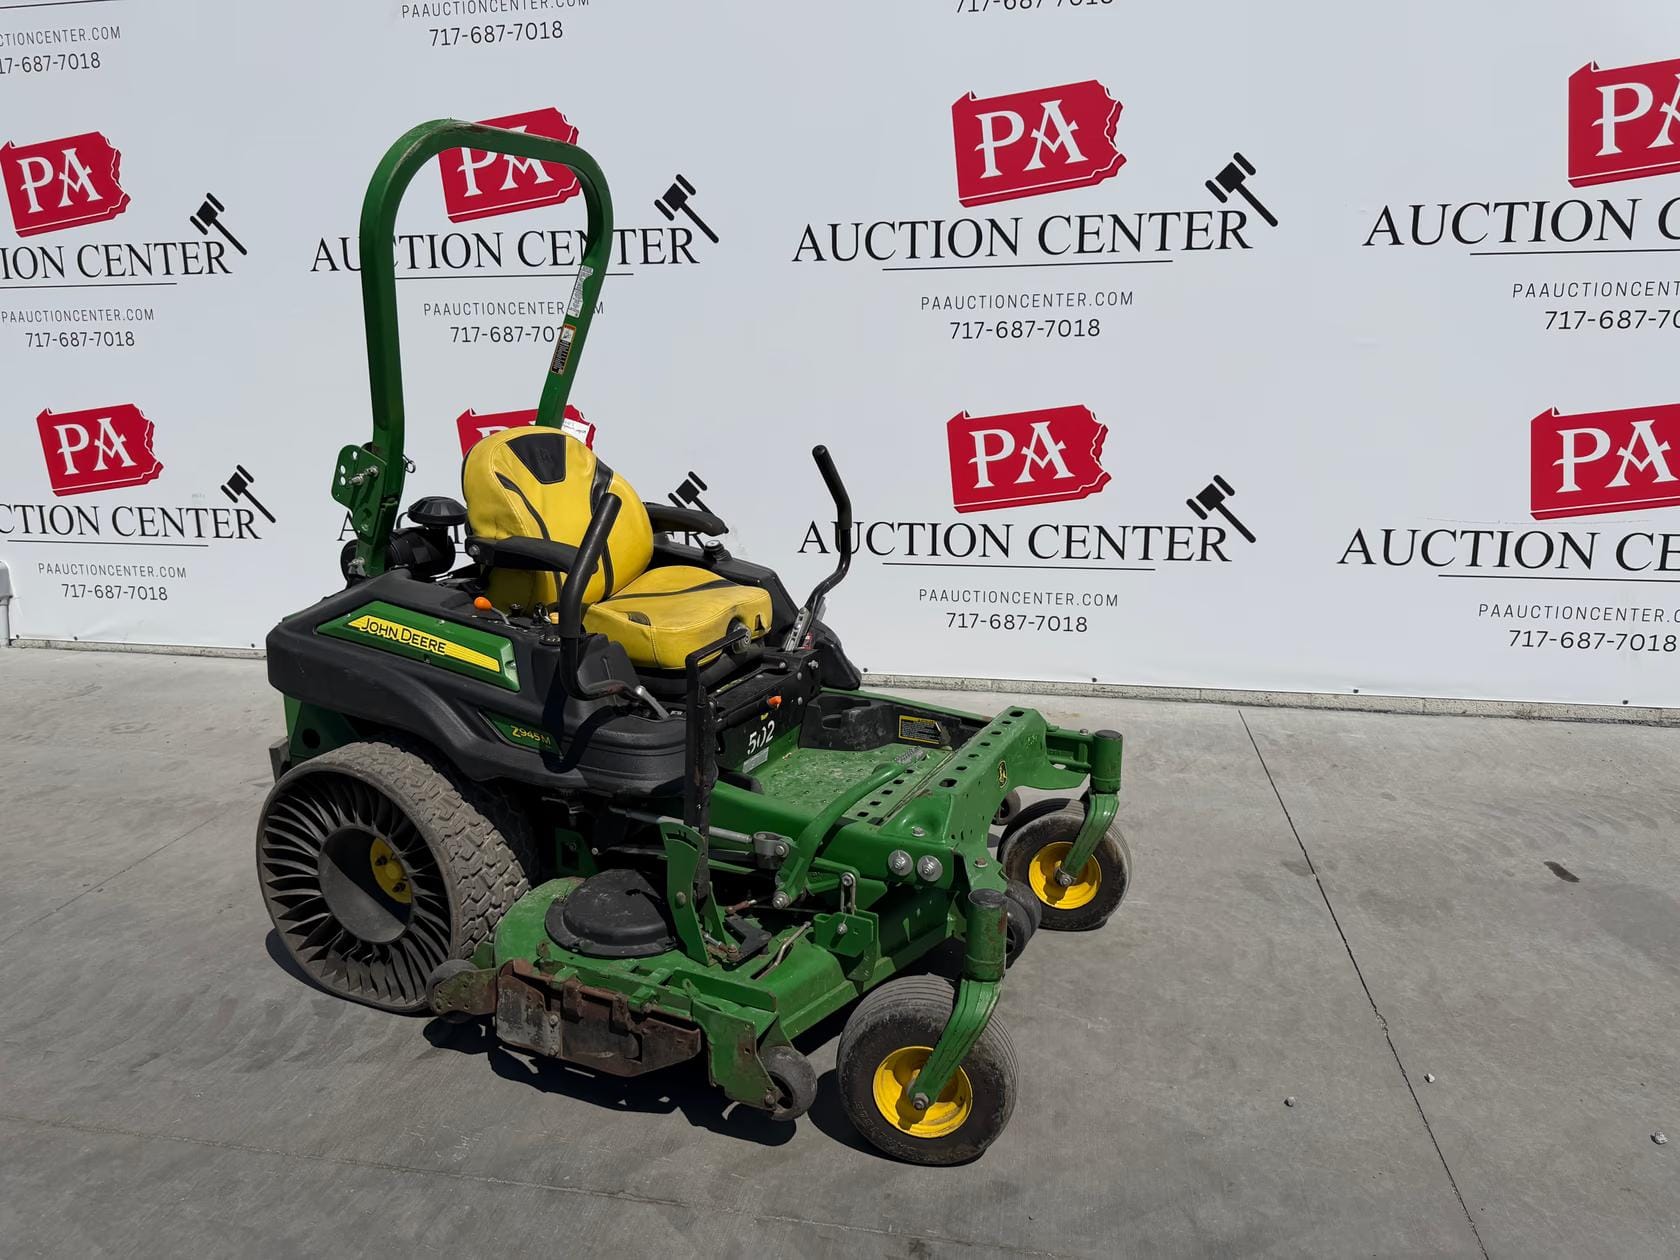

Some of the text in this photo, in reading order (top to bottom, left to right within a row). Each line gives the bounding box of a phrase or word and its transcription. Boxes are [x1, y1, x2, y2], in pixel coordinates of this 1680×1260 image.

[429, 20, 563, 46] 717-687-7018
[974, 99, 1088, 179] PA
[16, 148, 103, 213] PA
[792, 210, 1253, 262] AUCTION CENTER
[1362, 199, 1642, 246] AUCTION
[77, 241, 232, 278] CENTER
[310, 232, 502, 272] AUTION
[423, 300, 604, 316] PAAUCTIONCENTERM
[922, 291, 1132, 310] PAAUCTIONCENTER.COM
[2, 309, 154, 323] PAAUCTIONCENTER.COM
[950, 319, 1100, 339] 717-687-7018
[25, 331, 134, 347] 717-687-7018
[449, 325, 562, 343] 717-687-70
[53, 417, 137, 475] PA
[968, 421, 1076, 489] PA
[1552, 419, 1679, 493] PA
[112, 505, 262, 540] CENTER
[797, 520, 1232, 562] AUCTION CENTER
[1337, 528, 1600, 570] AUCTION
[38, 563, 186, 578] PAAUCTIONCENTER.COM
[61, 584, 168, 600] 717-687-7018
[920, 589, 1117, 606] PAAUCTIONCENTER.COM
[361, 618, 446, 653] JOHN DEERE
[946, 613, 1087, 632] 717-687-7018
[1509, 630, 1676, 652] 717-687-7018
[510, 724, 551, 745] Z945M
